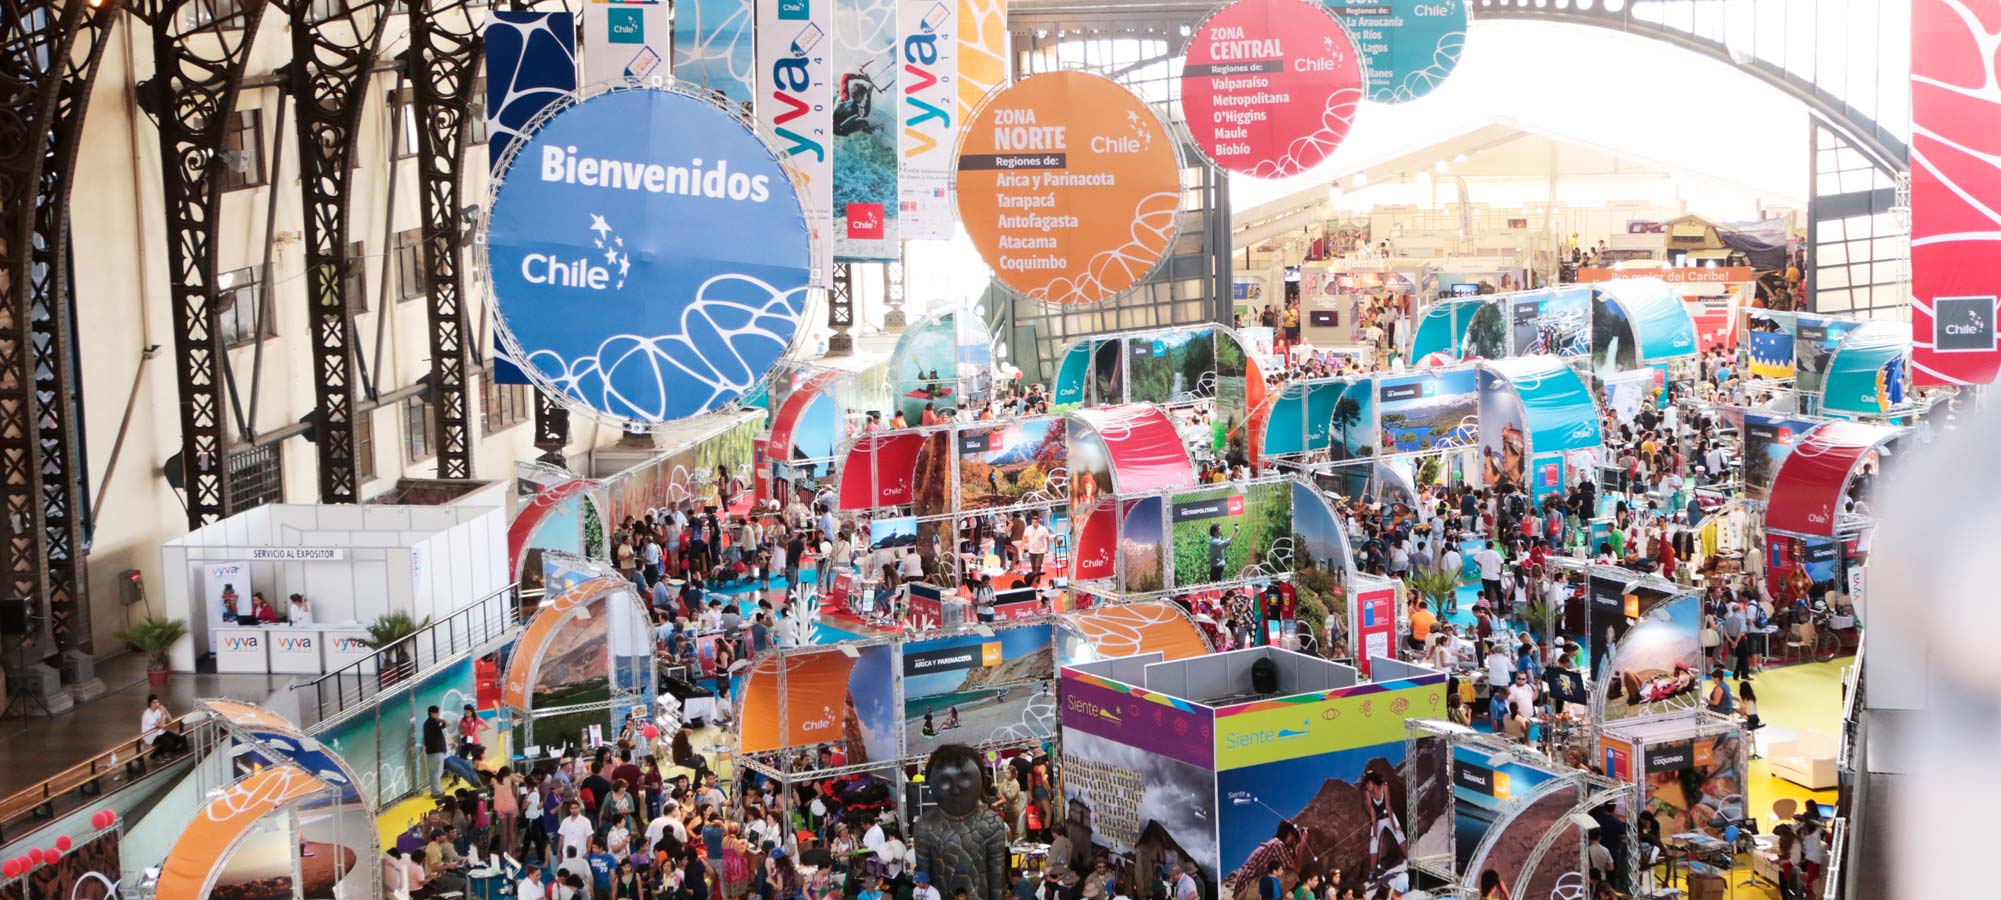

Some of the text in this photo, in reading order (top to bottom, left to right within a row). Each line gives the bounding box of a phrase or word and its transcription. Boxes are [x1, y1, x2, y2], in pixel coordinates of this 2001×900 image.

[783, 3, 801, 11] Chile
[1346, 6, 1389, 16] Regiones de:
[1414, 4, 1448, 17] Chile
[1346, 16, 1404, 27] La Araucanía
[613, 24, 634, 34] Chile
[1210, 26, 1245, 41] ZONA
[1363, 29, 1382, 40] Ríos
[1210, 38, 1284, 61] CENTRAL
[1363, 43, 1389, 55] Lagos
[1212, 64, 1263, 75] Regiones de:
[1294, 57, 1335, 72] Chile
[1212, 76, 1269, 91] Valparaíso
[904, 33, 951, 159] vyva
[1213, 92, 1290, 107] Metropolitana
[994, 108, 1036, 125] ZONA
[994, 126, 1067, 150] NORTE
[1214, 126, 1248, 140] Maule
[1090, 135, 1141, 154] Chile
[1215, 143, 1251, 156] Biobío
[995, 155, 1059, 168] Regiones de:
[540, 144, 770, 204] Bienvenidos
[996, 171, 1115, 191] Arica y Parinacota
[996, 192, 1056, 210] Tarapacá
[852, 220, 874, 229] Chile
[998, 213, 1079, 231] Antofagasta
[998, 234, 1057, 249] Atacama
[999, 254, 1067, 273] Coquimbo
[521, 252, 610, 290] Chile
[1667, 271, 1685, 282] del
[1687, 271, 1729, 282] Caribe!
[1945, 323, 1978, 335] Chile
[1060, 388, 1075, 396] Chile
[883, 487, 902, 496] Chile
[1808, 513, 1825, 524] Chile
[253, 549, 335, 559] SERVICIO AL EXPOSITOR
[1081, 558, 1105, 569] Chile
[212, 566, 238, 577] vyva
[224, 636, 257, 650] vyva
[278, 636, 311, 650] vyva
[332, 637, 366, 651] vyva
[914, 660, 932, 669] ARICA
[937, 654, 973, 666] PARINACOTA
[1067, 694, 1099, 718] Siente
[802, 719, 829, 732] Chile
[1225, 728, 1276, 751] Siente
[1227, 790, 1246, 799] Siente
